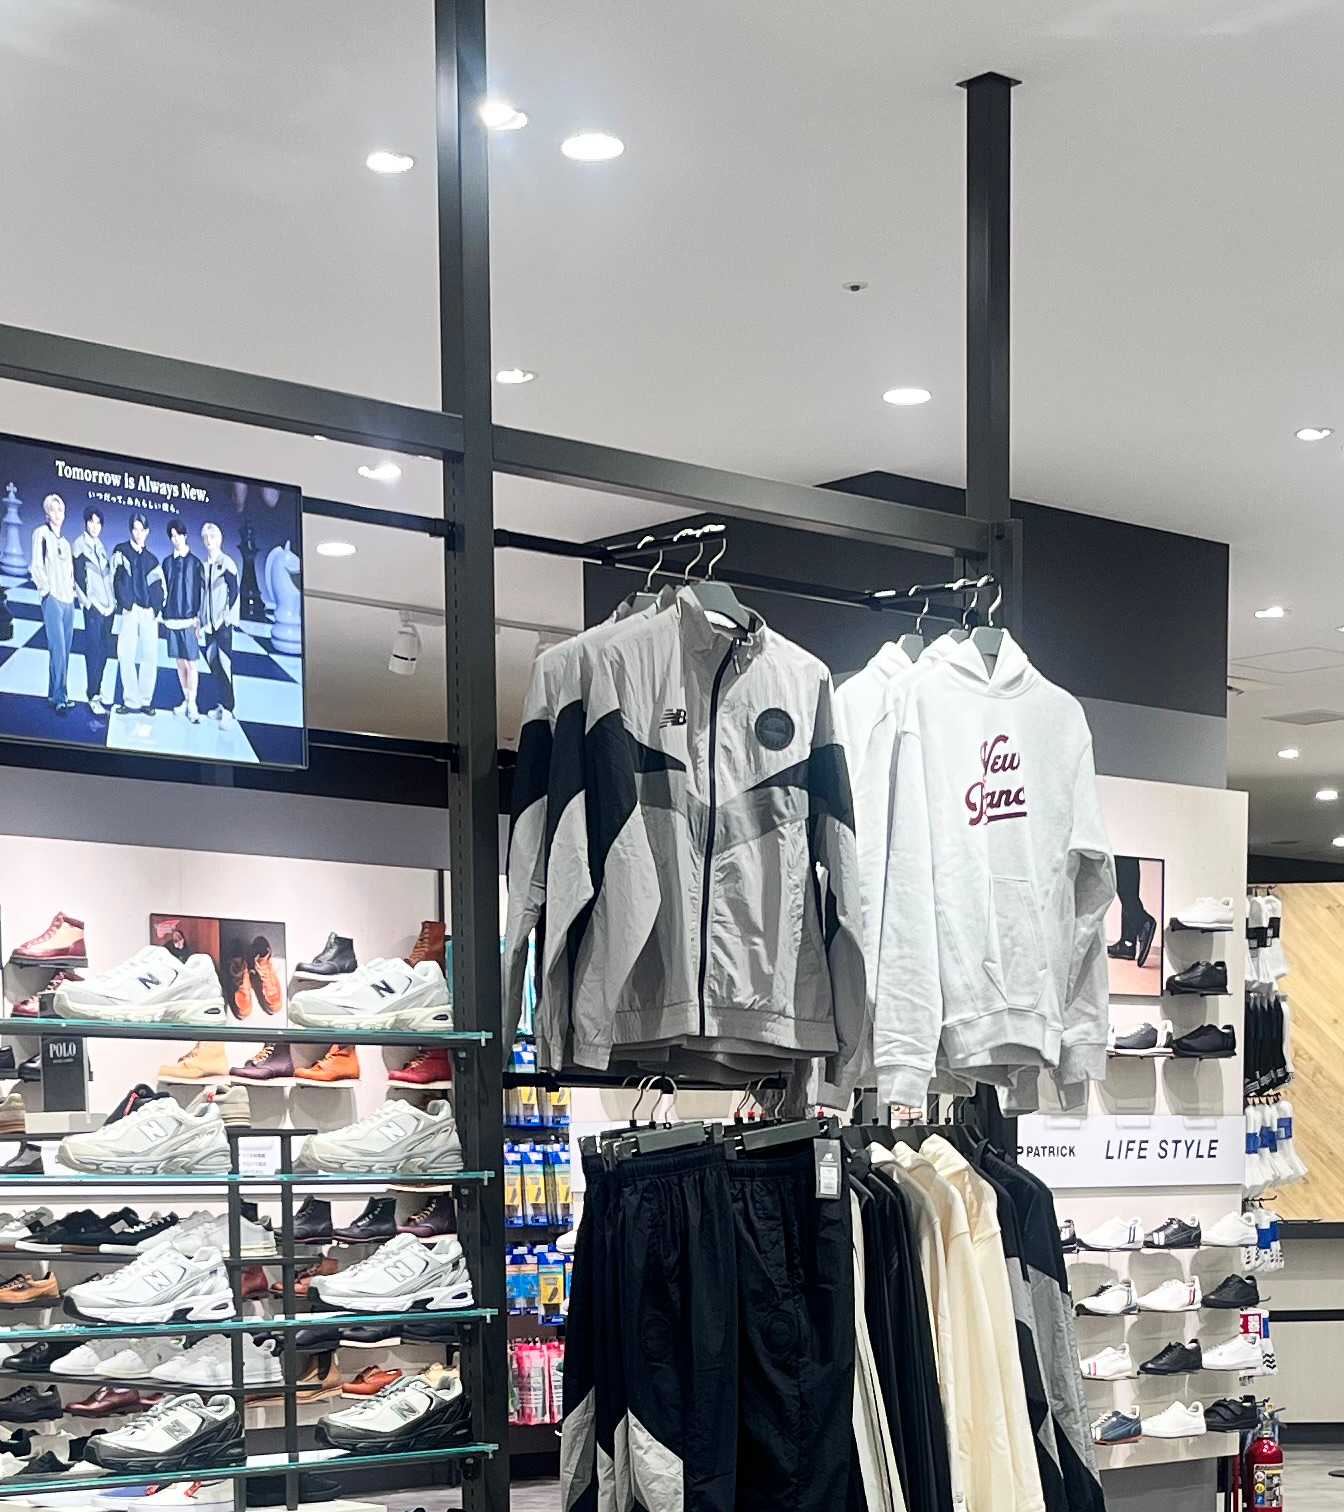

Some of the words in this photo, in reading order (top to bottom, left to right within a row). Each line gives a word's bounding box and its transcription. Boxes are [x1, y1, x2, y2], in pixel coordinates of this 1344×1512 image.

[55, 461, 122, 488] Tomorrow
[124, 473, 135, 490] is
[138, 476, 179, 500] Always
[181, 483, 210, 503] New.
[49, 1042, 77, 1058] POLO
[1026, 1145, 1076, 1158] PATRICK
[1105, 1139, 1149, 1159] LIFE
[1157, 1139, 1219, 1159] STYLE
